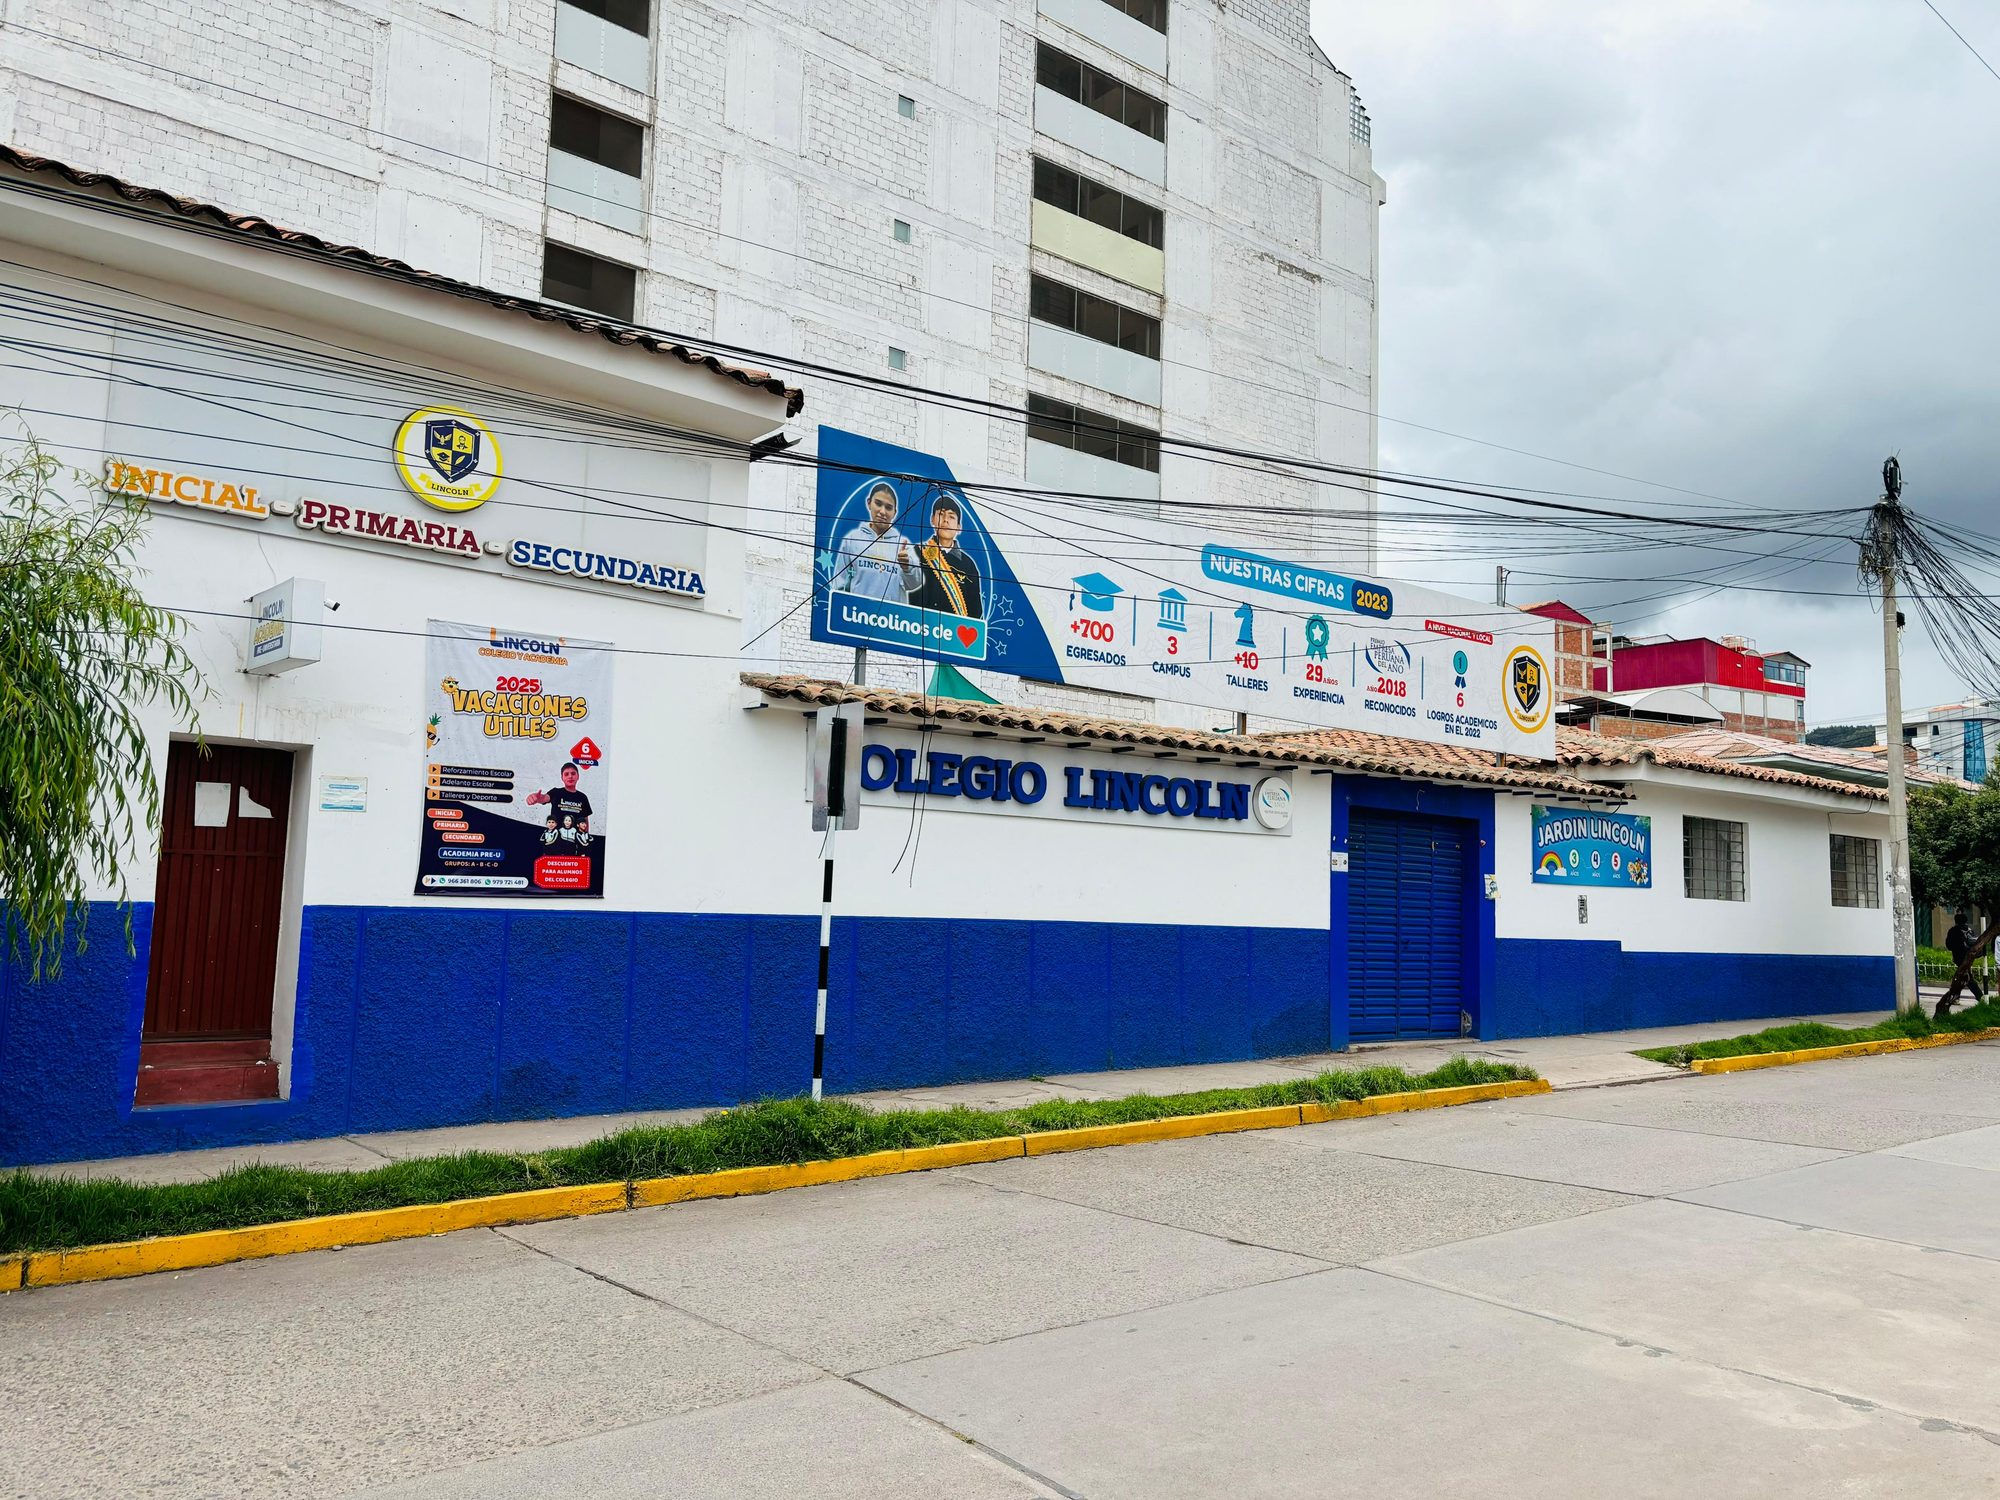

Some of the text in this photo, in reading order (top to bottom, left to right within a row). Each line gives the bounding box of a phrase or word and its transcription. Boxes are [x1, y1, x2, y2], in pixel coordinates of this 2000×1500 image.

[430, 482, 469, 497] LINCOLN
[110, 463, 266, 514] INICIAL
[302, 499, 481, 554] PRIMARIA
[513, 540, 706, 595] SECUNDARIA
[858, 560, 898, 575] LINCOLN
[1210, 552, 1388, 612] NUESTRAS CIFRAS 2023
[842, 605, 953, 641] Lincolinos de
[1070, 618, 1114, 643] +700
[490, 627, 560, 656] LINCOLN
[1167, 635, 1178, 655] 3
[1476, 632, 1492, 644] LOCAL
[478, 647, 517, 660] COLEGIO
[523, 653, 569, 667] ACADEMIA
[1066, 645, 1127, 667] EGRESADOS
[1234, 651, 1259, 670] +10
[1374, 650, 1405, 665] PERUANA
[1377, 660, 1387, 669] DEL
[1152, 661, 1191, 678] CAMPUS
[1306, 663, 1323, 683] 29
[495, 675, 542, 694] 2025
[1226, 674, 1269, 692] TALLERES
[1377, 676, 1407, 698] 2018
[451, 689, 588, 720] VACACIONES
[1293, 686, 1345, 705] EXPERIENCIA
[1456, 692, 1465, 708] 6
[1364, 699, 1417, 718] RECONOCIDOS
[483, 714, 558, 739] UTILES
[1426, 709, 1498, 731] LOGROS ACADEMICOS
[1444, 723, 1481, 738] EN EL 2022
[581, 742, 591, 754] 6
[442, 766, 490, 777] Reforzamiento
[441, 778, 495, 788] Adelanto Escolar
[861, 744, 1251, 820] OLEGIO LINCOLN
[441, 791, 466, 799] Talleres
[471, 793, 498, 802] Deporte
[1537, 816, 1646, 854] JARDIN LINCOLN
[442, 850, 501, 859] ACADEMIA PRE-U
[1571, 851, 1578, 865] 3
[1593, 853, 1599, 866] 4
[1613, 854, 1619, 868] 5
